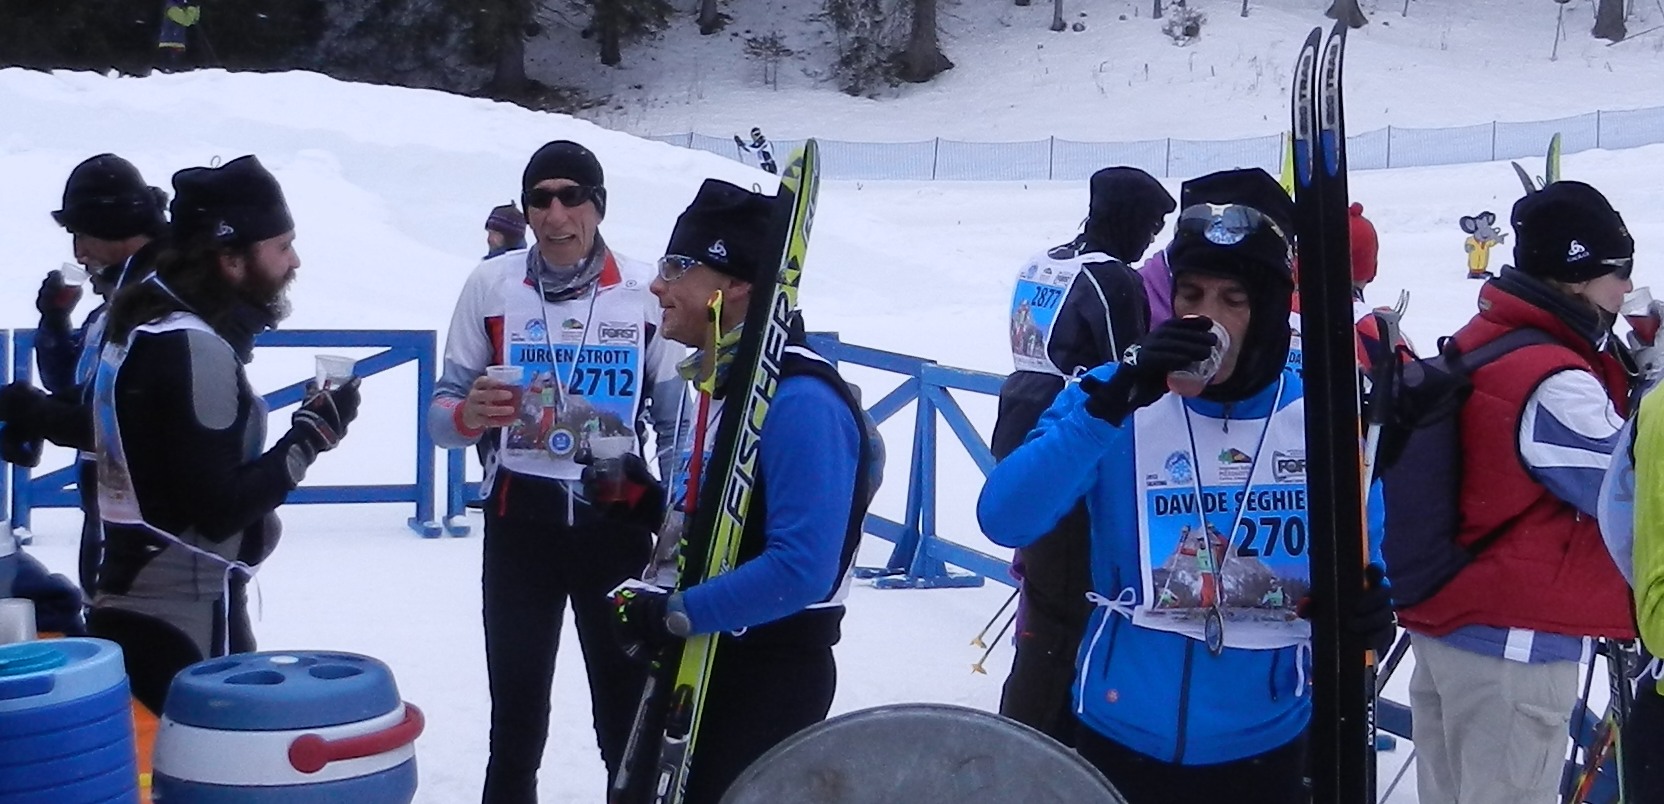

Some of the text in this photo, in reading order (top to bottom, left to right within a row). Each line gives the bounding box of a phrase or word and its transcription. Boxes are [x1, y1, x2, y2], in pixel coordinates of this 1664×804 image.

[1031, 286, 1062, 309] 2877
[602, 328, 637, 339] FORST
[578, 349, 630, 364] STROTT
[568, 368, 634, 396] 2712
[726, 291, 792, 527] FISCHER
